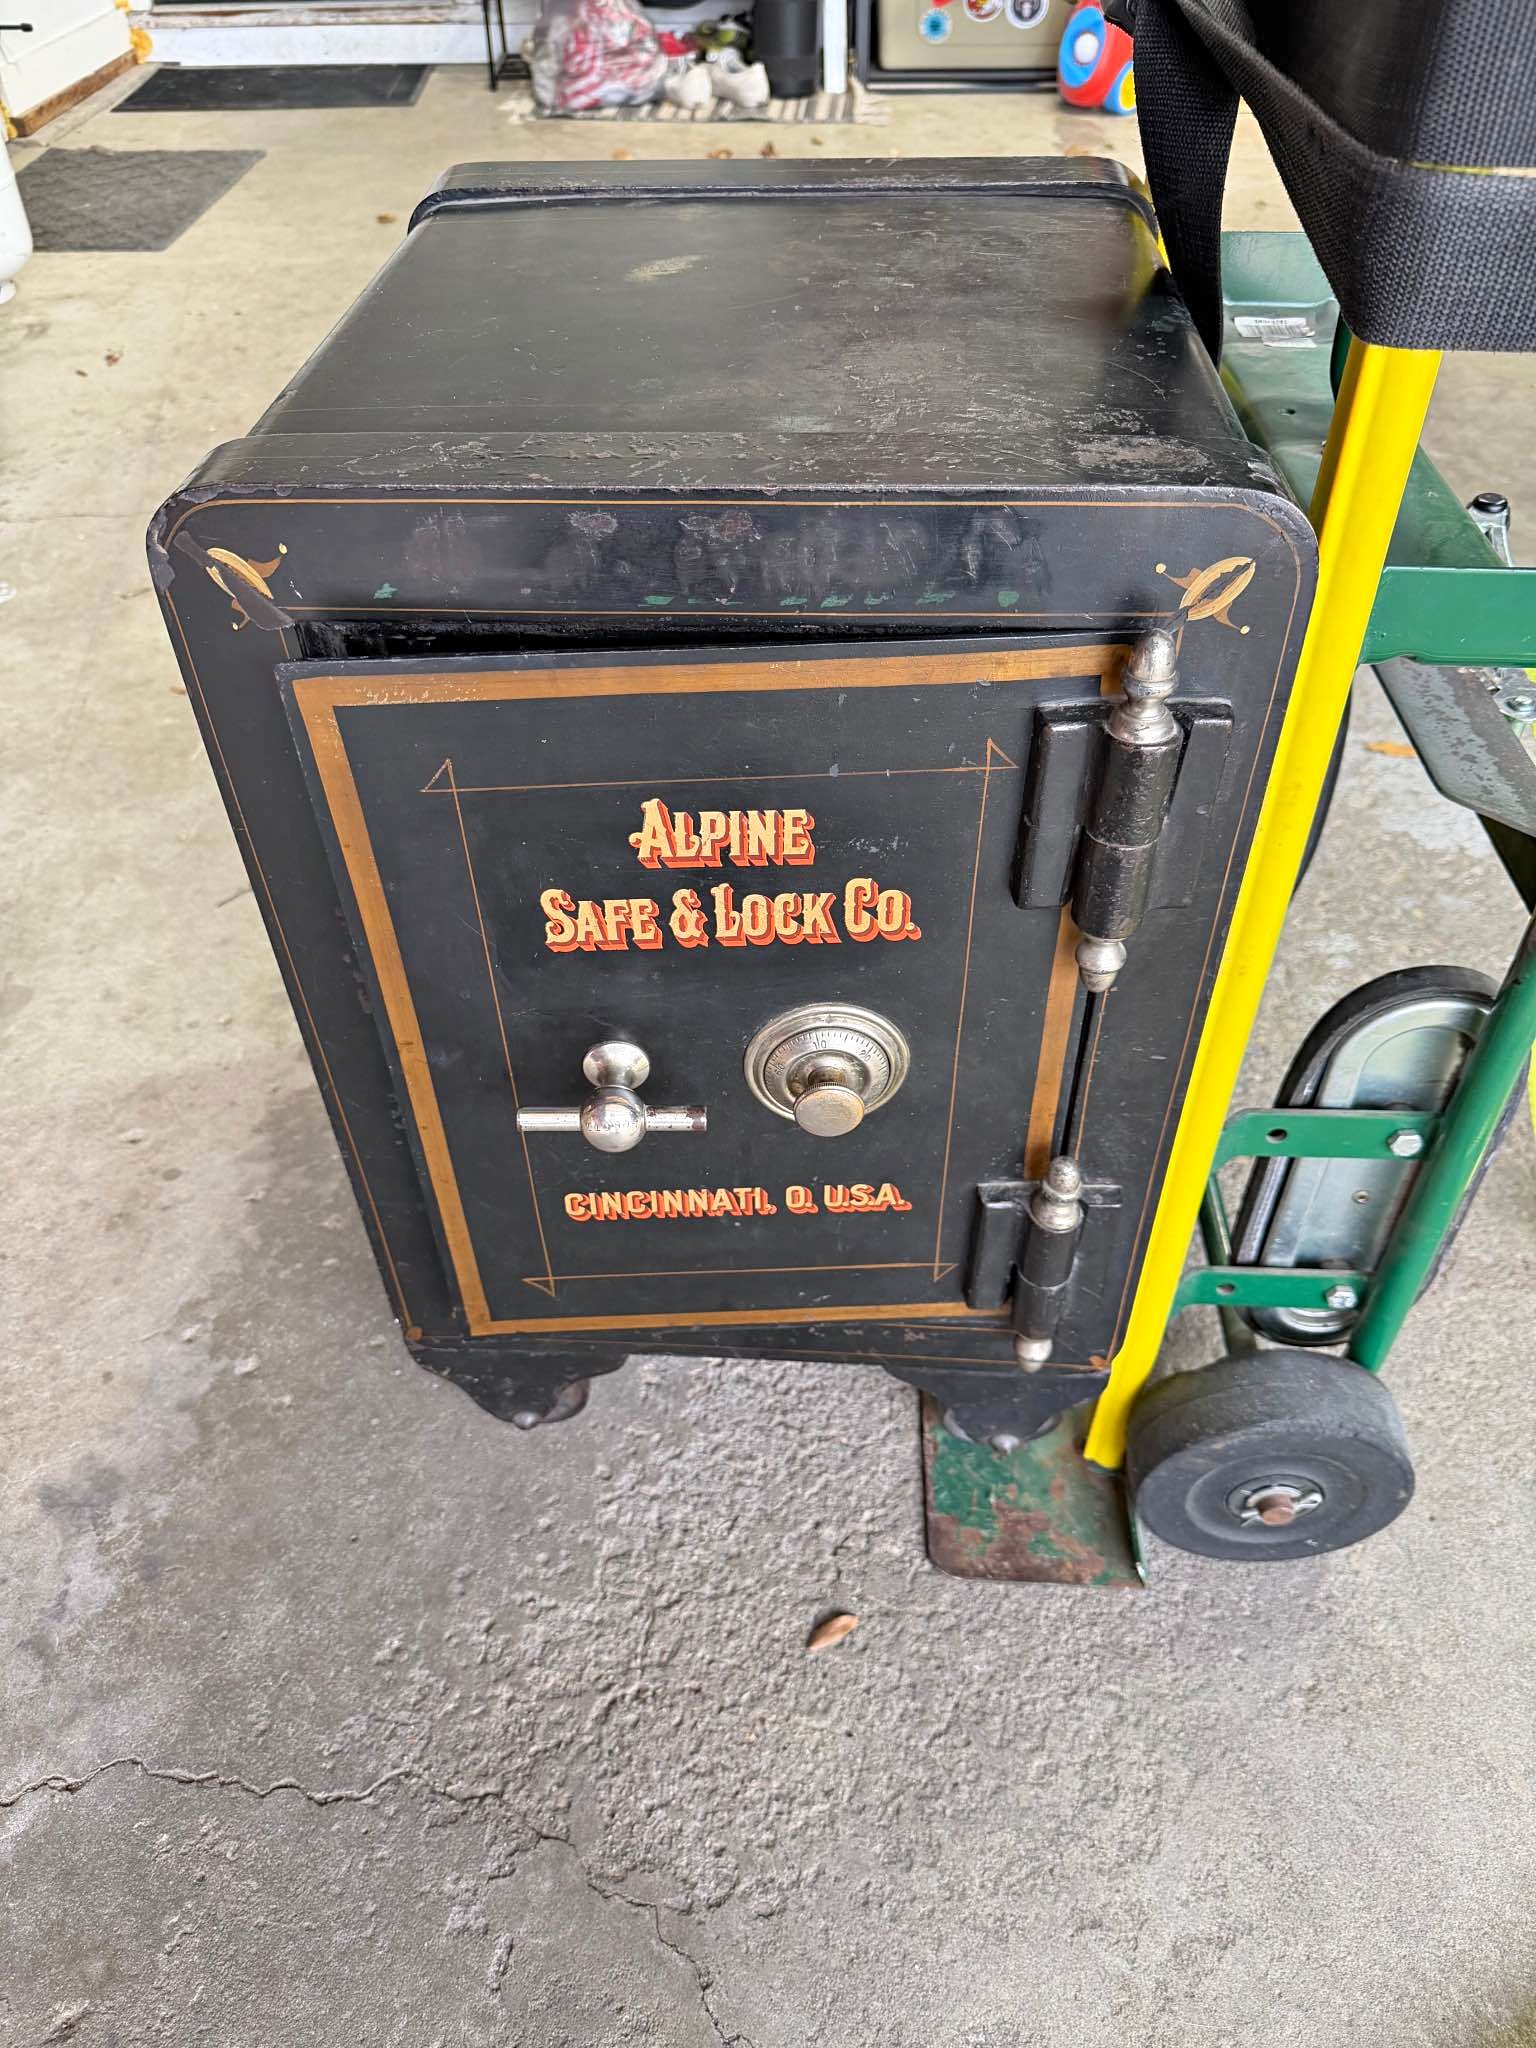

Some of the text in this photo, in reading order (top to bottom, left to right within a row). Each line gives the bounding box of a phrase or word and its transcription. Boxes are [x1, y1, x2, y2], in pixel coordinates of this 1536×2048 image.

[629, 798, 815, 869] ALPINE
[540, 889, 663, 953] SAFE
[670, 888, 709, 949] &
[711, 883, 842, 948] LOCK
[813, 1039, 827, 1050] 10
[859, 1049, 872, 1062] 20
[786, 1186, 818, 1214] O.
[824, 1184, 912, 1213] U.S.A.
